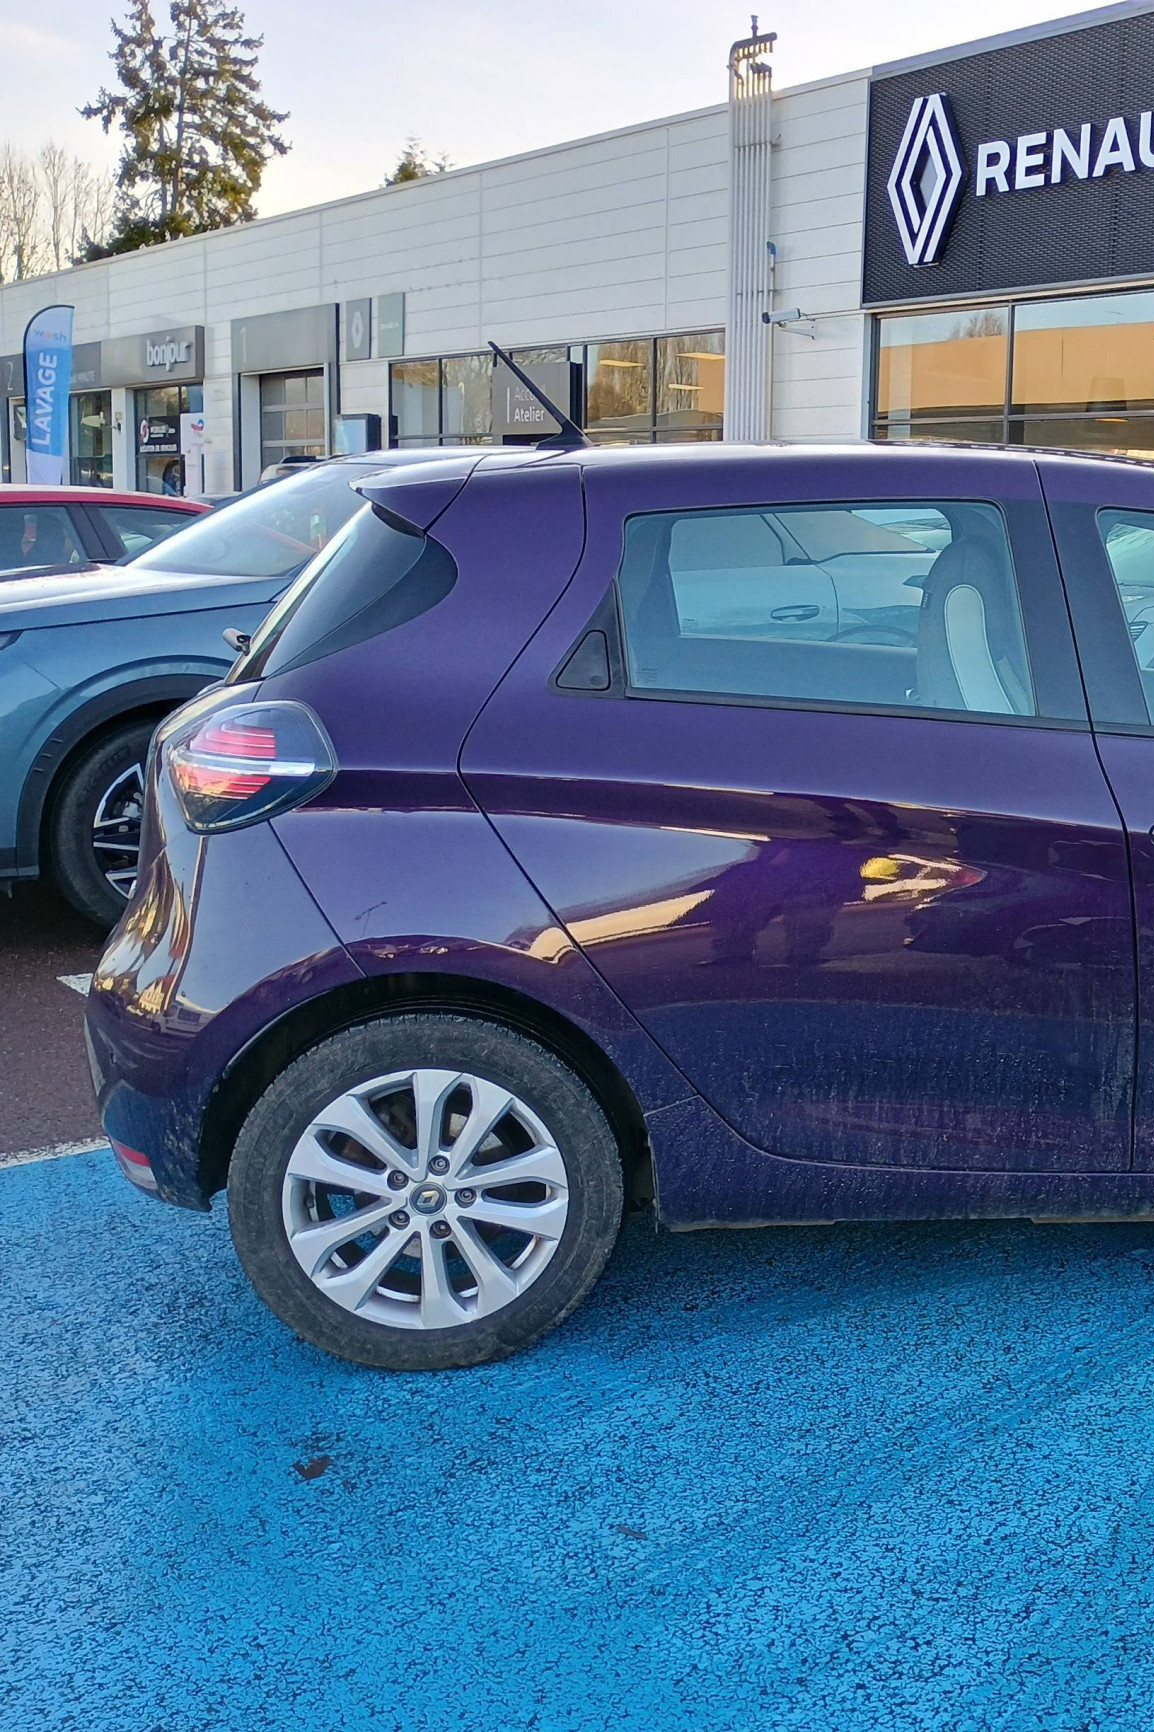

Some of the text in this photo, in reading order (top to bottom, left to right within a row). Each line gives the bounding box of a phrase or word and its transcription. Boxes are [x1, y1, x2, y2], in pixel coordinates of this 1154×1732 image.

[33, 328, 67, 343] wash
[239, 326, 247, 363] 1
[145, 336, 190, 372] bonjour
[6, 361, 14, 391] 2
[31, 352, 58, 446] LAVAGE
[513, 405, 545, 422] Atelier
